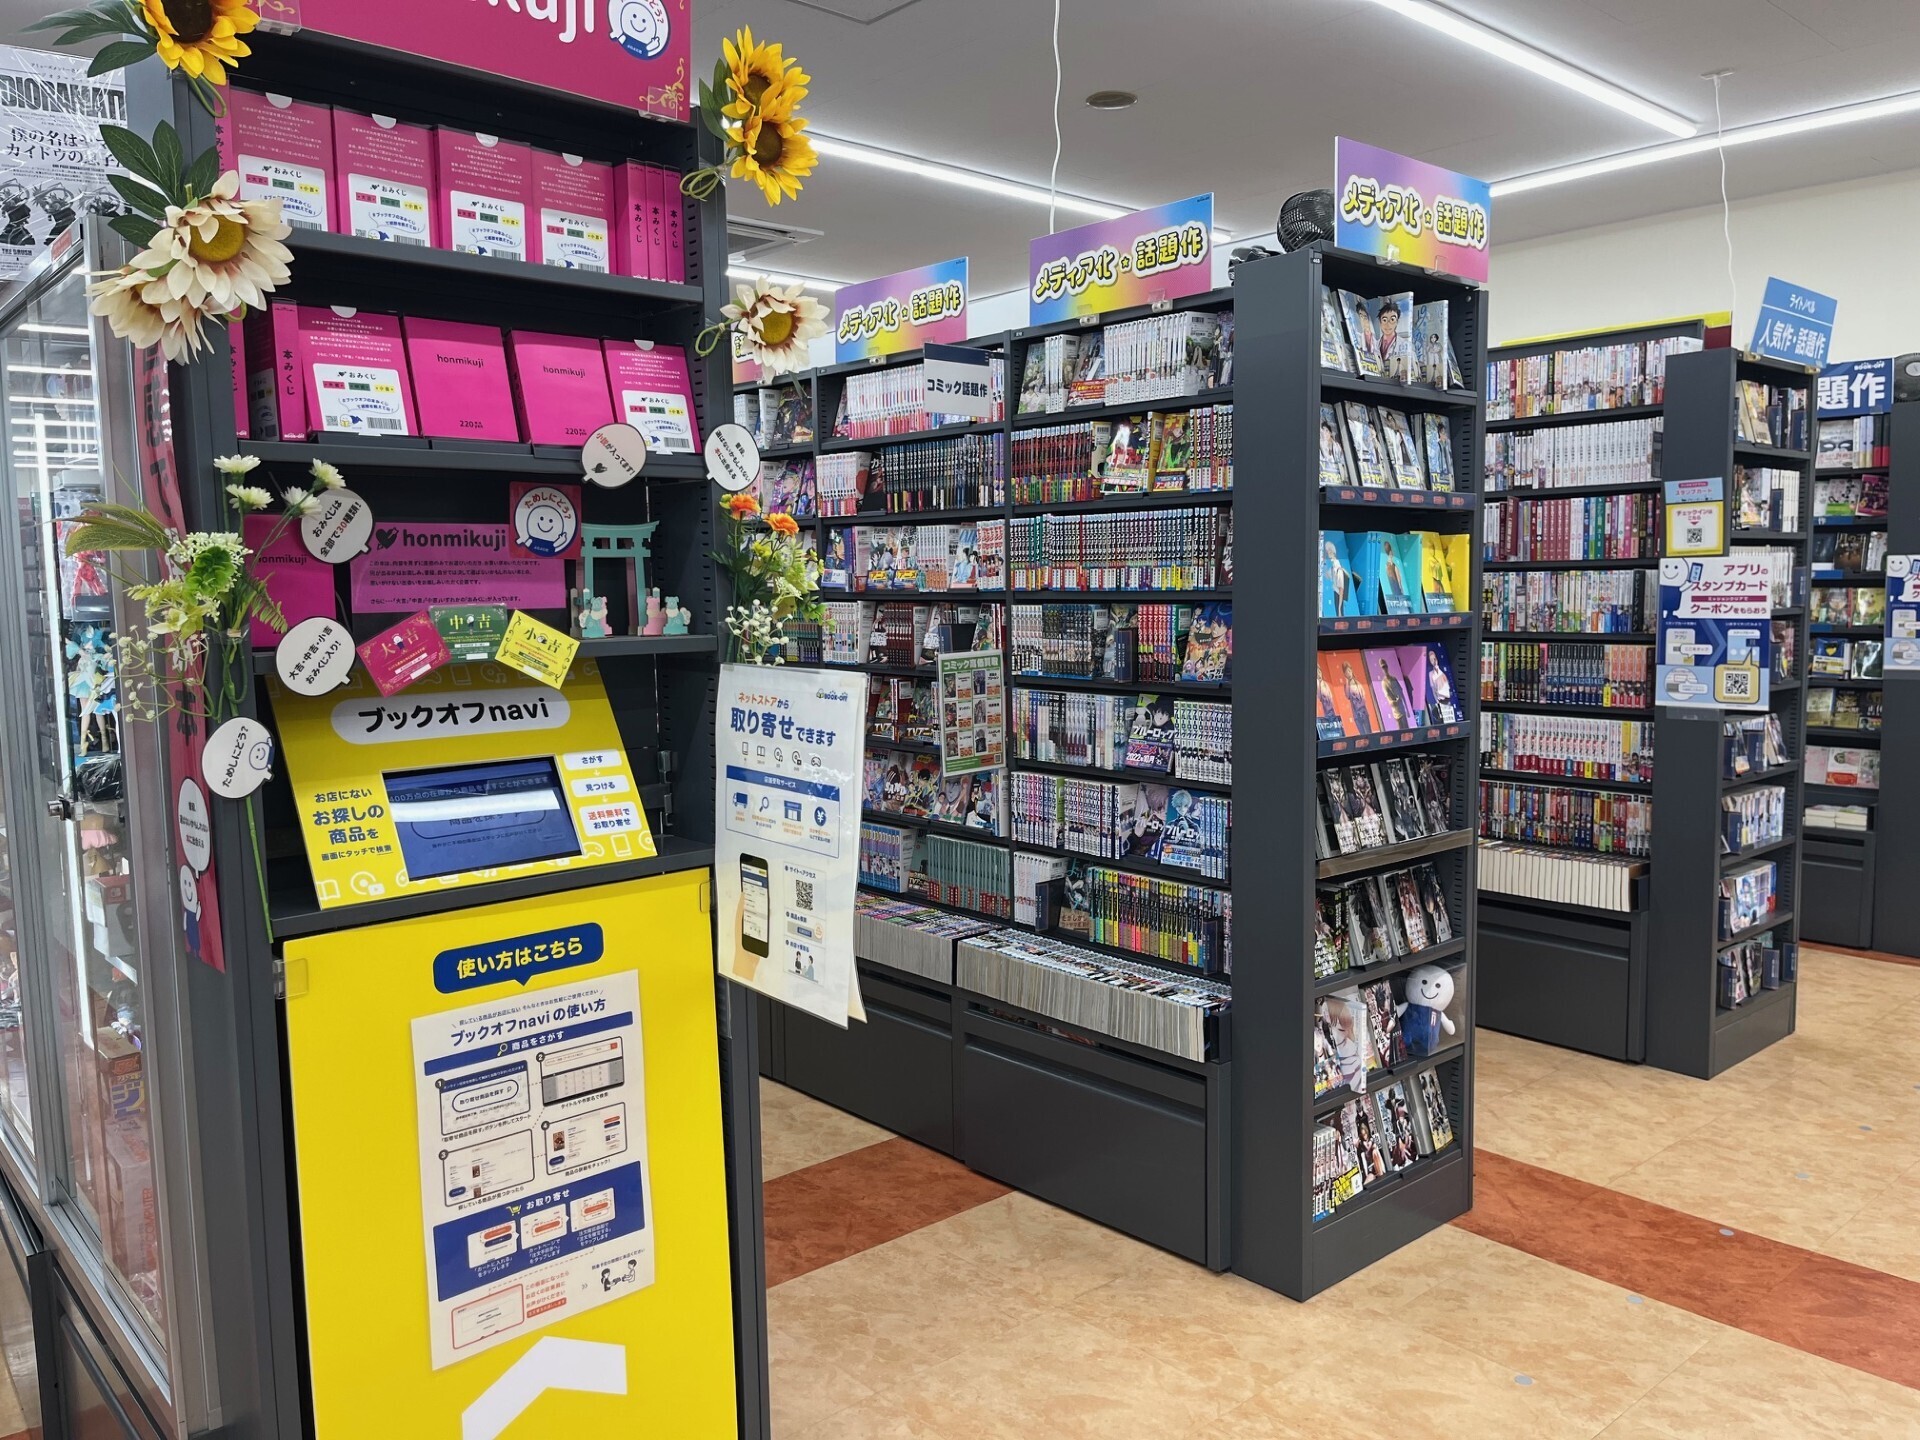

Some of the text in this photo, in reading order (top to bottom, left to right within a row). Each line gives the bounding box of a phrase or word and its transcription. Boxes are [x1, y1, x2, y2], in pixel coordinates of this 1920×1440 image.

[274, 166, 302, 178] おみくじ
[382, 185, 407, 196] おみくじ
[481, 202, 505, 212] おみくじ
[1344, 182, 1485, 242] メディア化 話題作
[568, 218, 590, 228] おみくじ
[634, 203, 643, 243] 本みくじ
[652, 206, 660, 246] 本みくじ
[670, 209, 678, 248] 本みくじ
[1036, 227, 1203, 296] メディア化 話題作
[911, 285, 961, 320] 話題作
[1759, 318, 1826, 362] 人気作・話題作
[437, 354, 485, 368] honmikuji
[282, 349, 296, 396] 本みくじ
[349, 371, 376, 381] おみくじ
[542, 365, 586, 378] honmikuji
[927, 377, 988, 397] コミック話題作
[648, 397, 670, 405] おみくじ
[565, 427, 579, 436] 220
[596, 432, 636, 476] 小説が入ってます!
[524, 491, 572, 520] ためしにどう?
[312, 499, 342, 538] おみくじは
[320, 501, 362, 557] 全部で30種類!
[402, 529, 507, 552] honmikuji
[1723, 563, 1768, 576] アプリの
[1691, 580, 1768, 591] スタンプカード
[1690, 604, 1767, 615] クーポンをもらおう
[450, 614, 491, 630] 中吉
[288, 625, 333, 681] 大吉・中吉・小吉
[305, 640, 341, 684] おみくじ入り!
[738, 692, 789, 709] ネットストアから
[359, 697, 549, 733] ブックオフnavi
[730, 707, 836, 746] 取り寄せできます
[222, 726, 249, 788] ためしにどう?
[581, 755, 604, 765] さがす
[314, 788, 372, 804] お店にない
[586, 781, 616, 792] 見つける
[312, 804, 385, 826] お探しの
[587, 807, 630, 822] 送料無料で
[593, 818, 632, 829] お取り寄せ
[328, 827, 379, 845] 商品を
[321, 845, 392, 862] 画面にタッチで検索
[456, 937, 583, 979] 使い方はこちら
[450, 998, 606, 1047] ブックオフnaviの使い方
[511, 1031, 564, 1051] 商品をさがす
[526, 1189, 570, 1210] お取り寄せ
